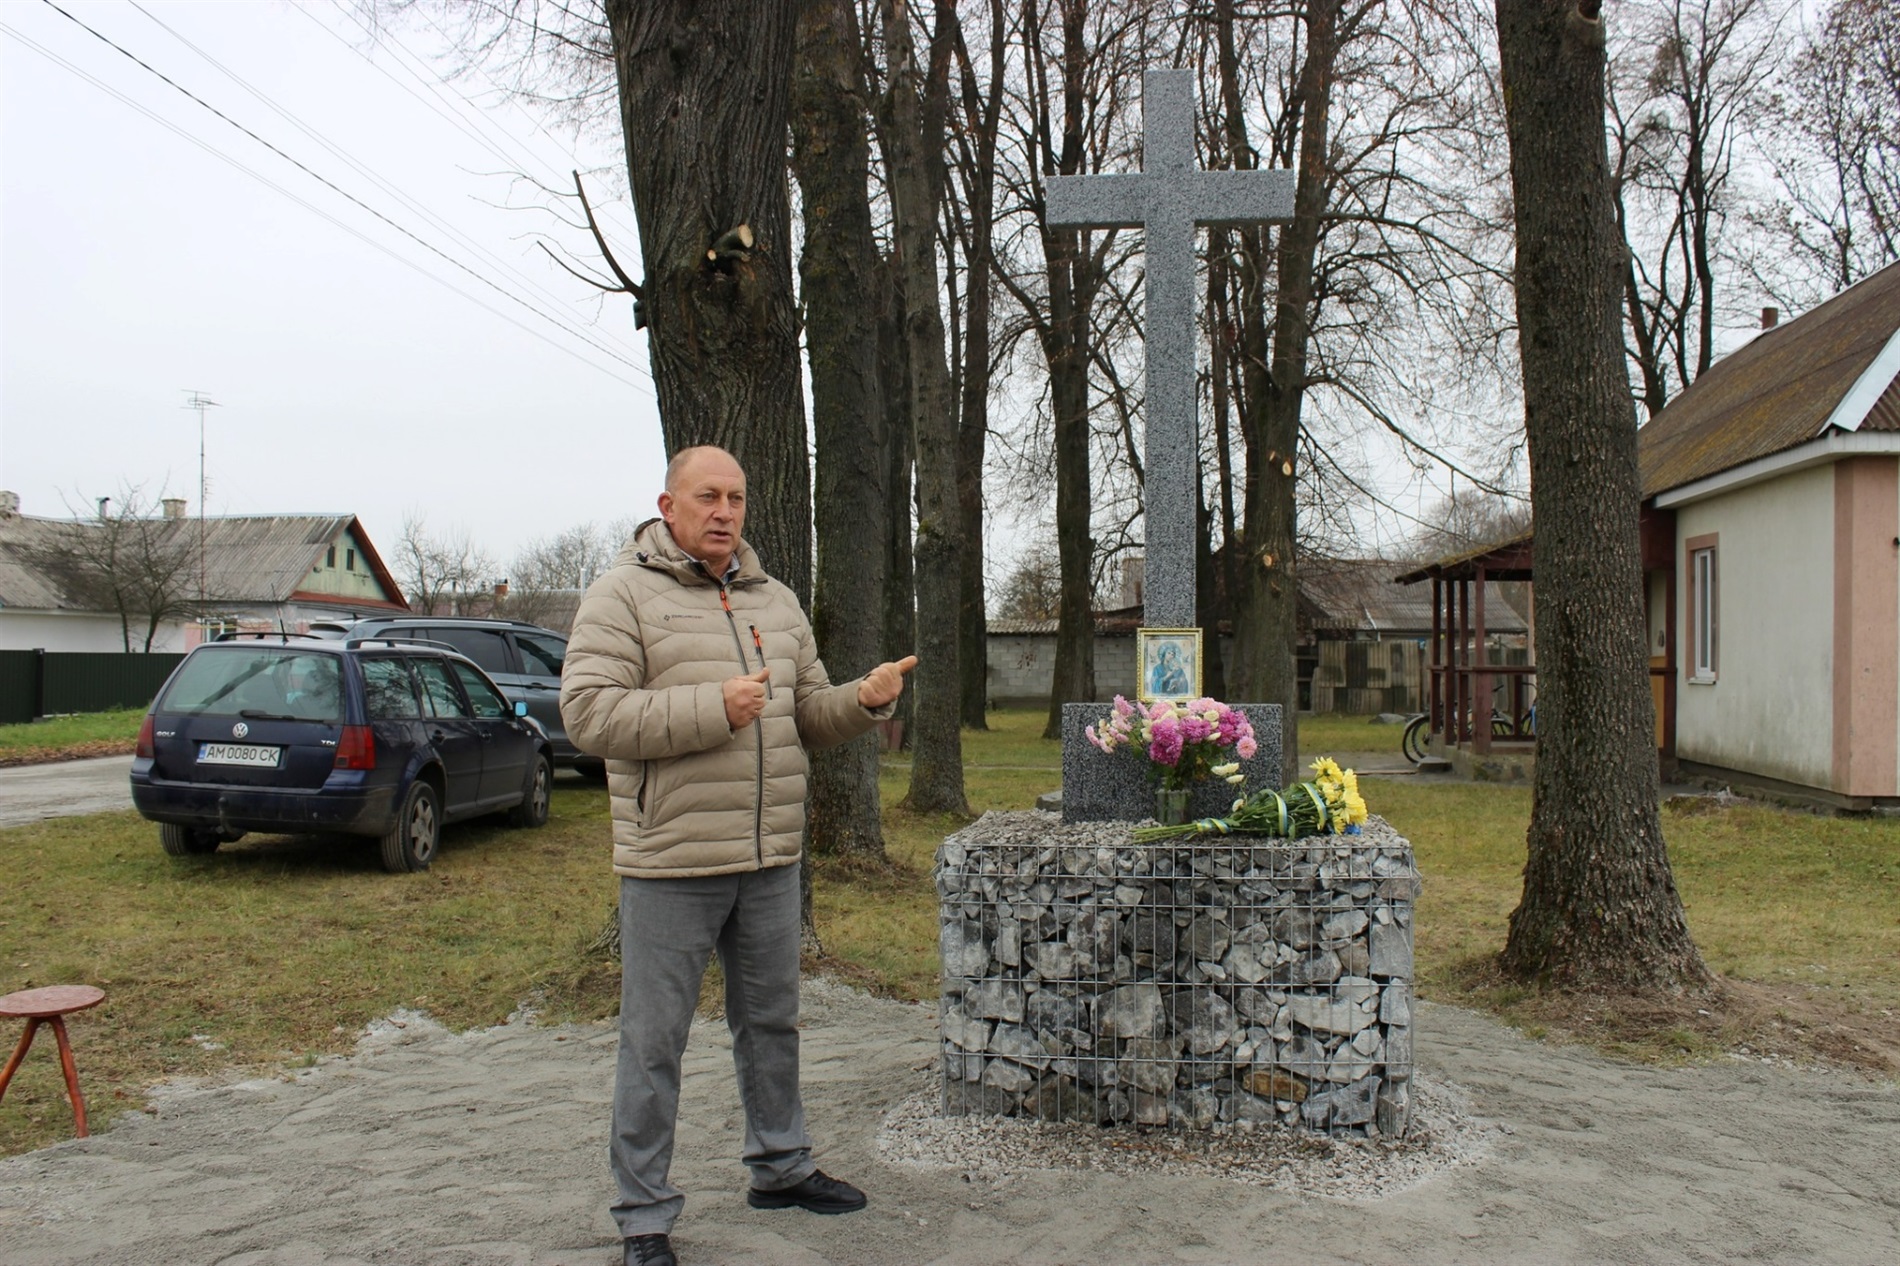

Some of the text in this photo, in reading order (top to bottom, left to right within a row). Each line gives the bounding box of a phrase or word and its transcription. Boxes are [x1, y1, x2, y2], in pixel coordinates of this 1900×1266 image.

[156, 730, 176, 738] GOLF
[206, 746, 279, 762] AM 0080 CK
